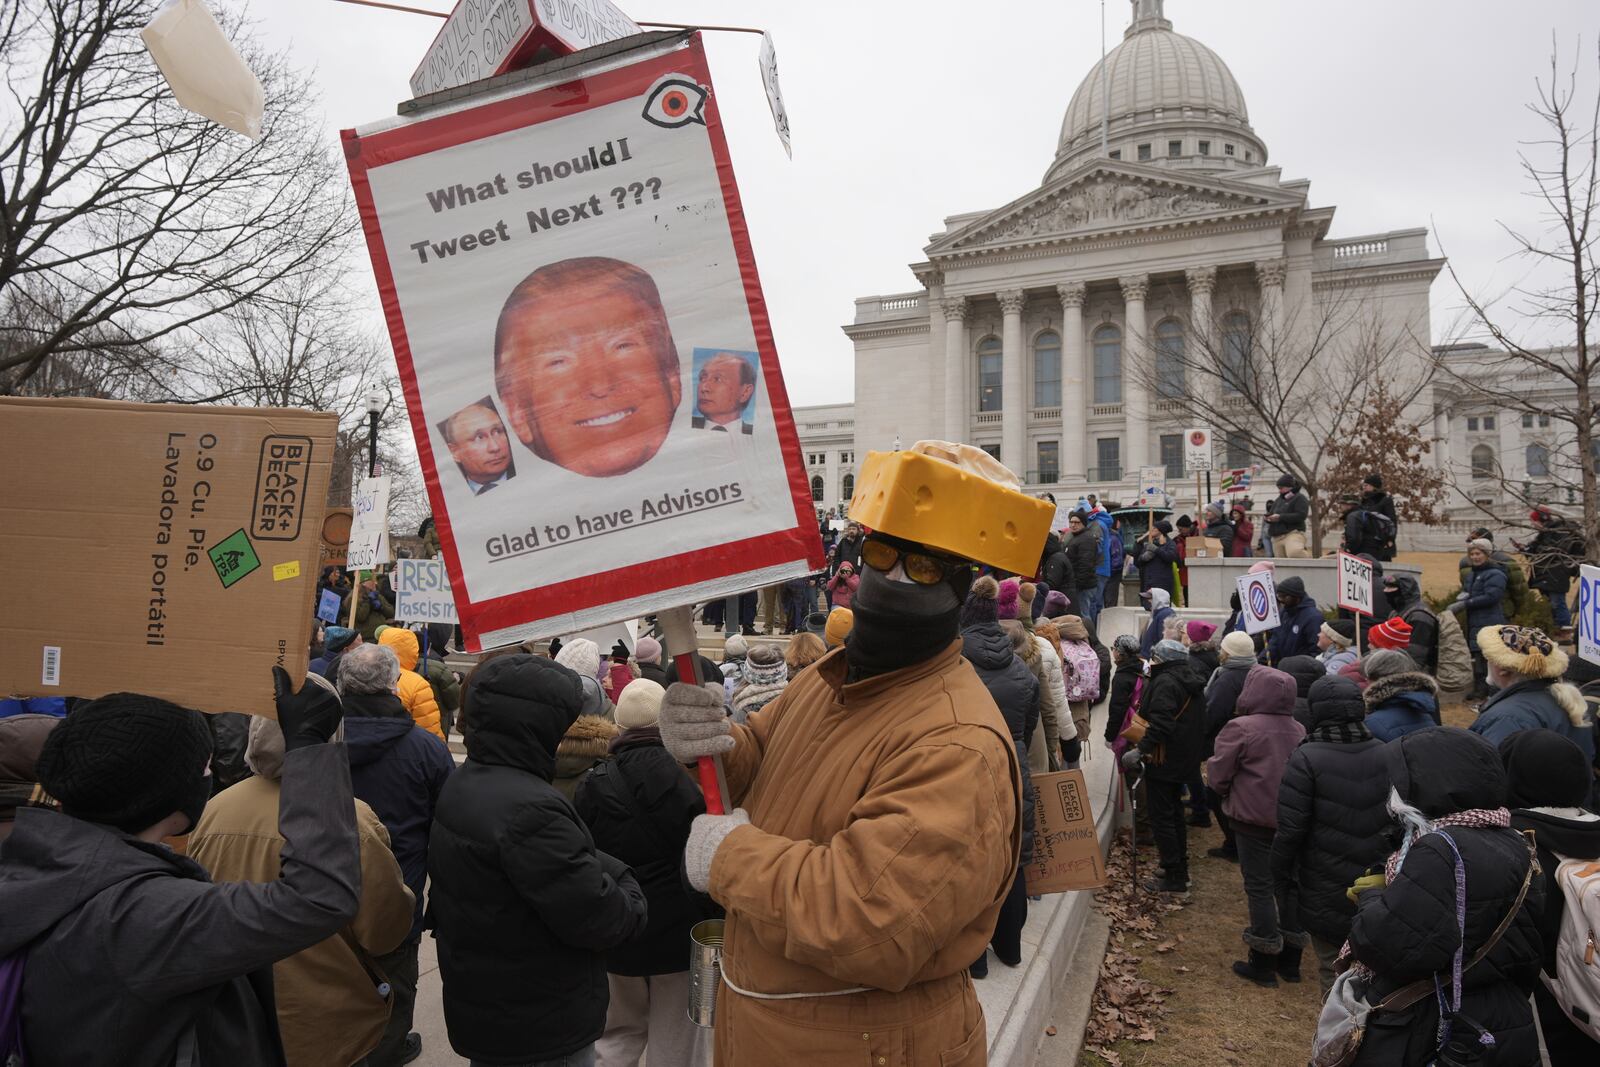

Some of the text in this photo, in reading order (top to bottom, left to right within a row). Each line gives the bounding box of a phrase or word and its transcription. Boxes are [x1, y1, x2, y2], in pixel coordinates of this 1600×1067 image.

[425, 137, 633, 214] What should I
[410, 176, 662, 264] Tweet Next ???
[183, 433, 217, 572] 0.9 Cu. Pie.
[259, 444, 285, 532] DECKER
[279, 444, 304, 531] BLACK+
[485, 481, 742, 557] Glad to have Advisors
[146, 432, 186, 646] Lavadora portátil
[214, 554, 230, 578] TPS
[1033, 786, 1047, 825] Machine
[1060, 784, 1075, 819] DECKER
[1067, 782, 1080, 817] BLACK+
